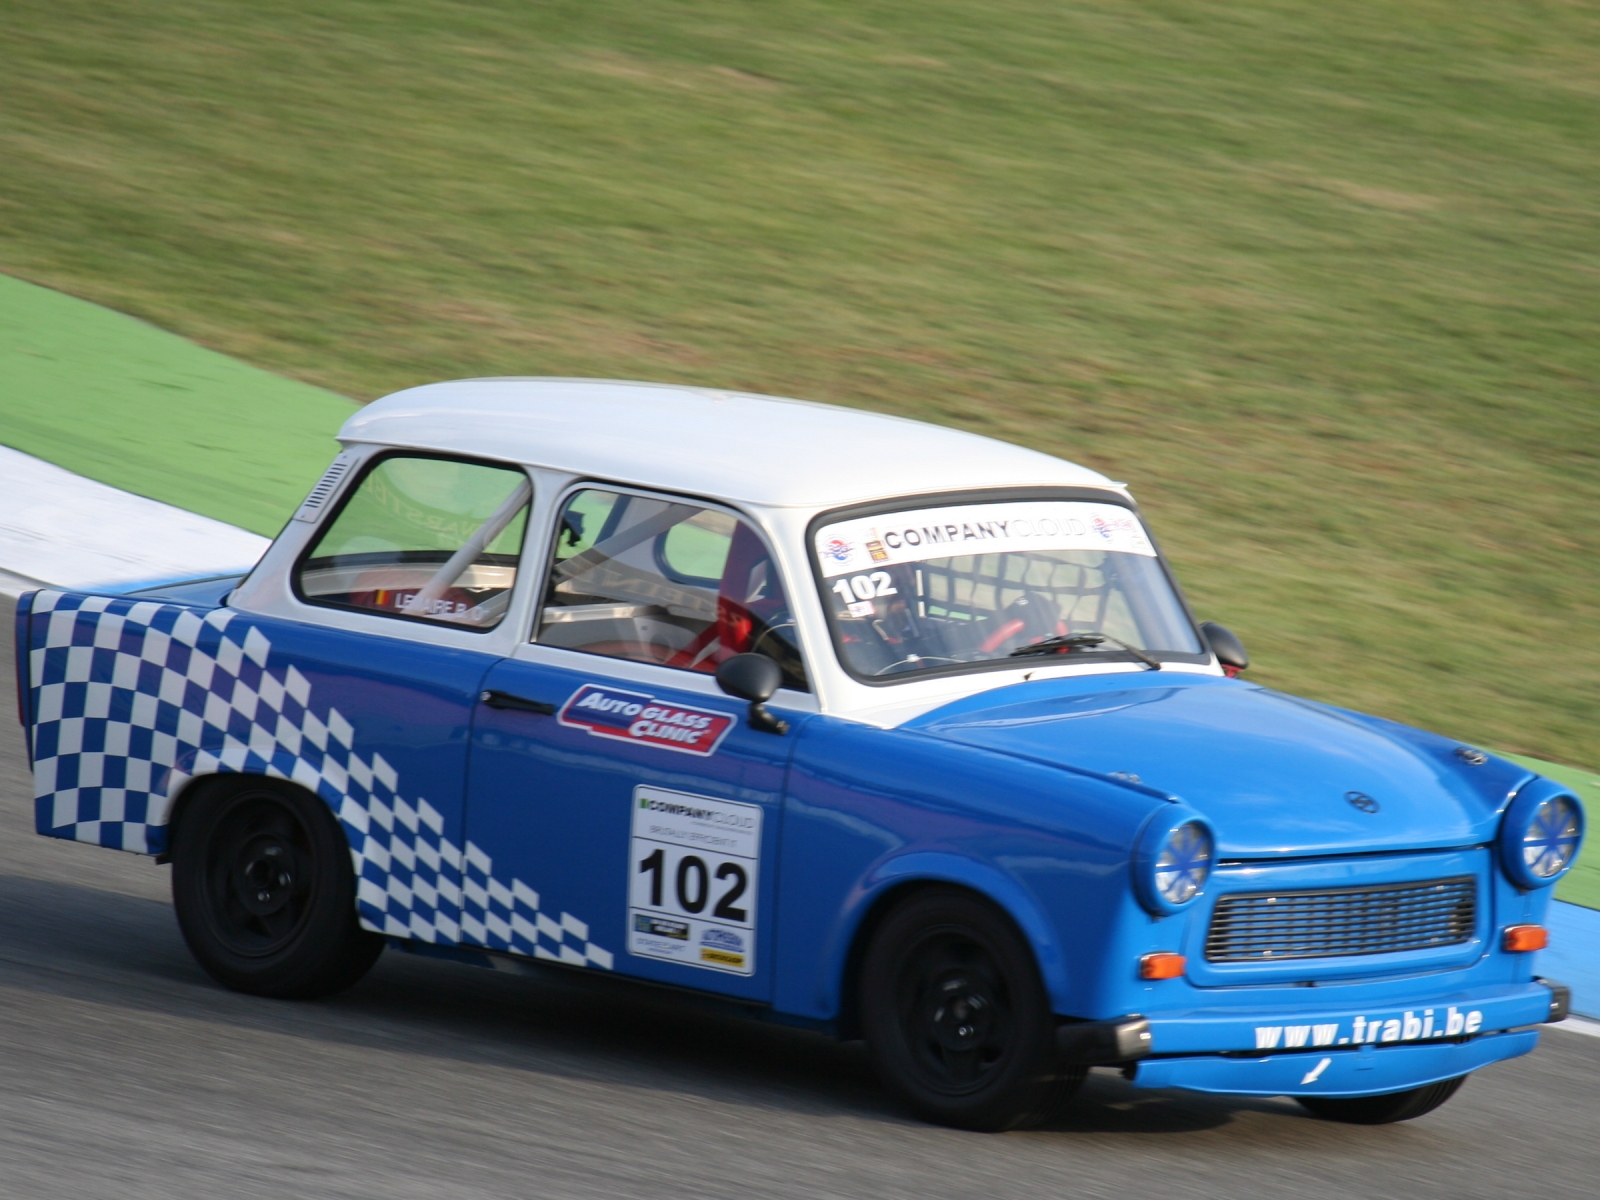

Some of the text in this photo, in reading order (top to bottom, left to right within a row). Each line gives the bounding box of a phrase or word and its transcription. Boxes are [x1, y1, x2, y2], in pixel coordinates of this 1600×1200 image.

[885, 518, 1085, 549] COMPANYCLOUD
[832, 571, 898, 604] 102
[628, 720, 703, 744] CLINIC
[639, 849, 748, 923] 102
[1255, 1006, 1483, 1049] www.trabi.be
